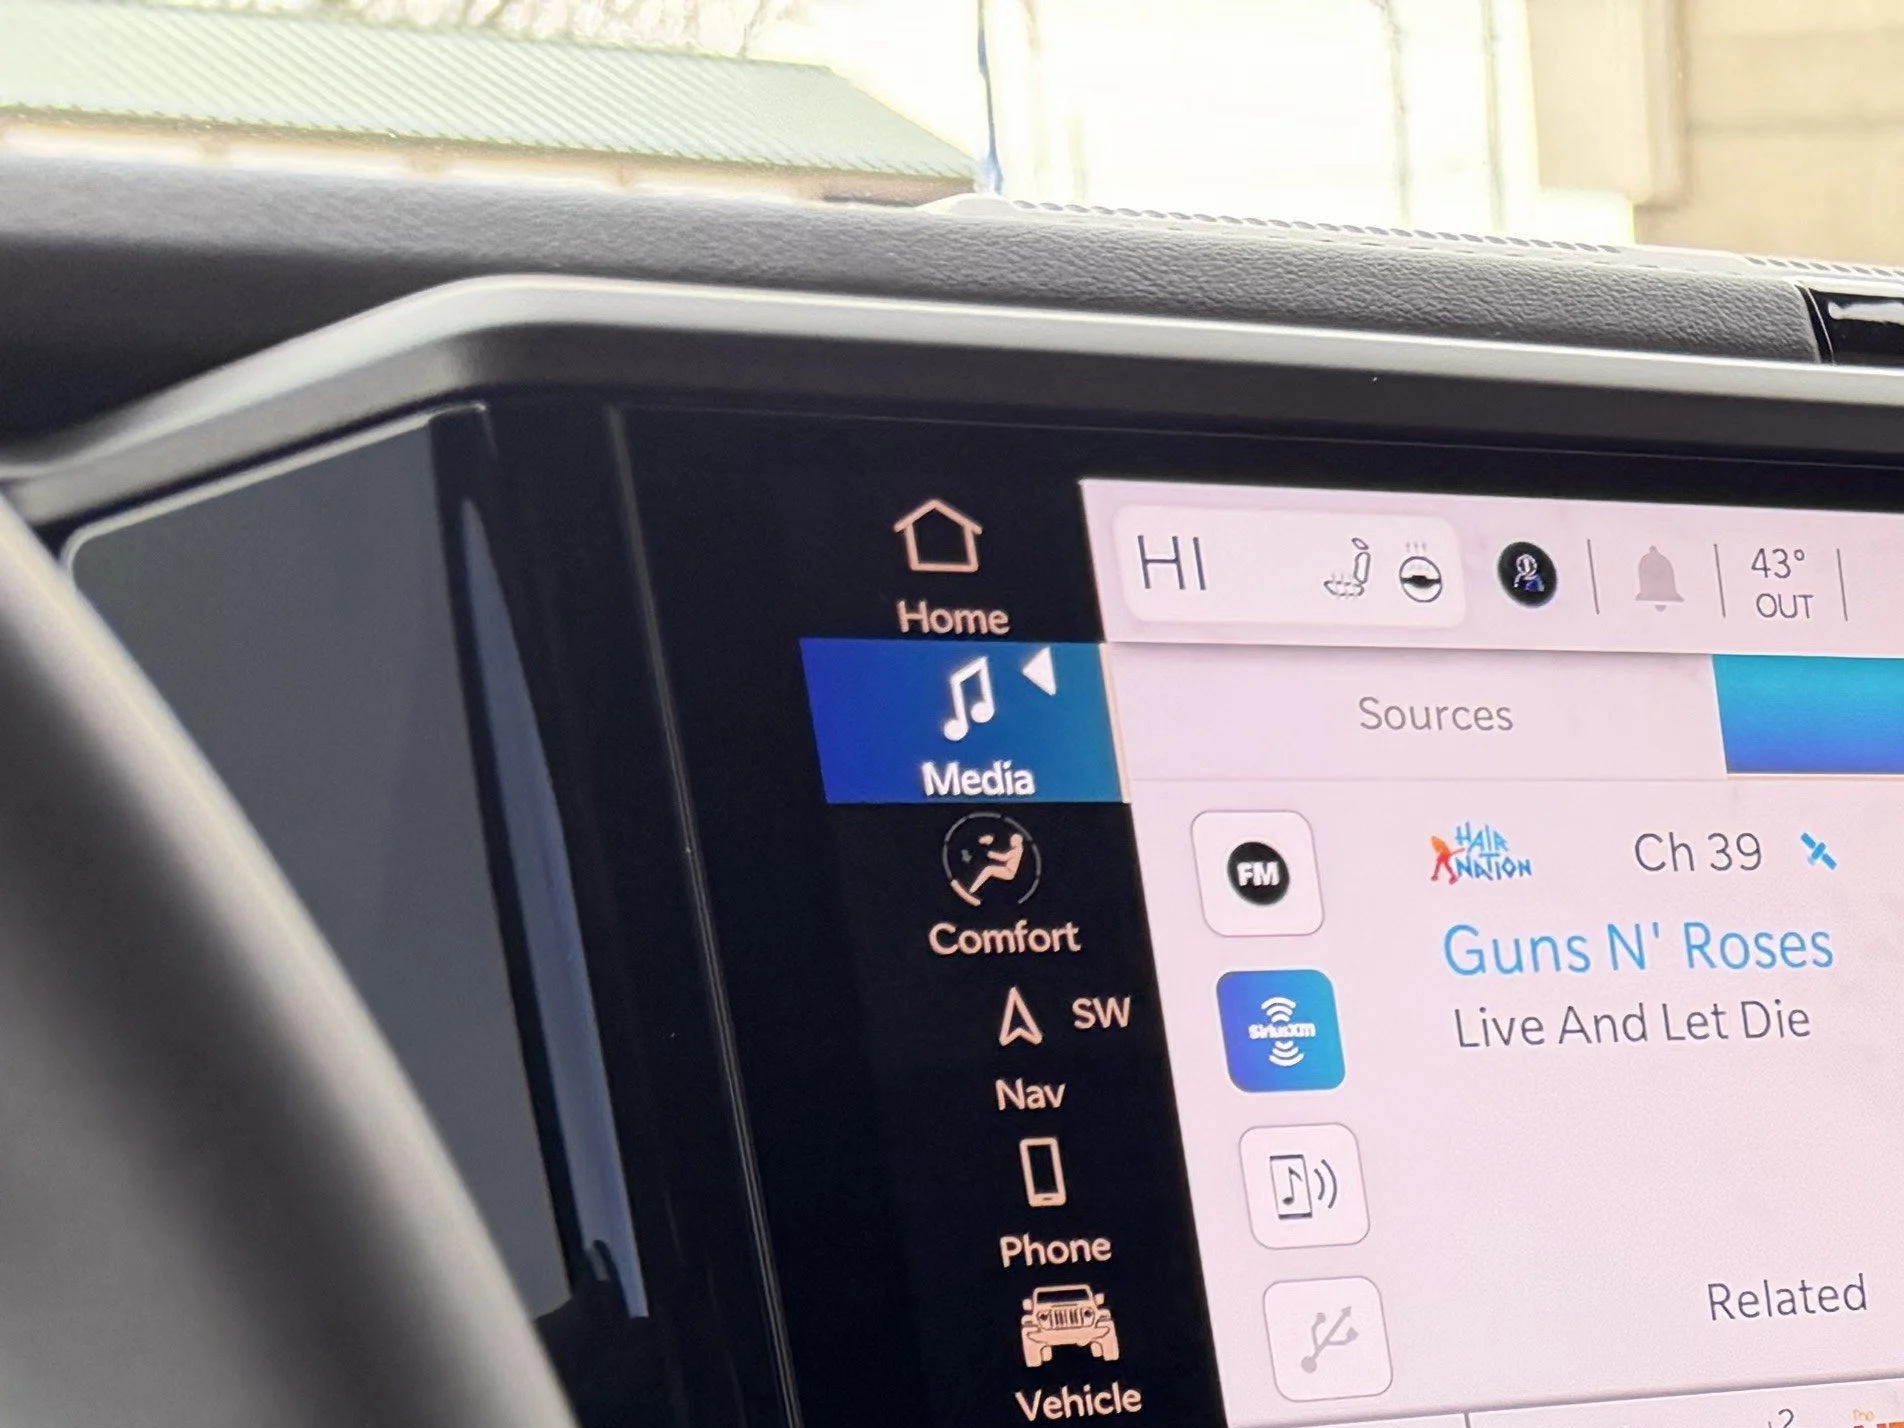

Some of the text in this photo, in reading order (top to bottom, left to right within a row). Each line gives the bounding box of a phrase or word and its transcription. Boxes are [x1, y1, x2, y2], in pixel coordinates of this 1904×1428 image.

[1136, 535, 1208, 592] HI
[1750, 547, 1806, 580] 43°
[899, 602, 1010, 636] Home
[1755, 592, 1814, 620] OUT
[1358, 695, 1514, 732] Sources
[921, 761, 1036, 796] Media
[1455, 821, 1510, 852] HAIR
[1634, 832, 1764, 872] Ch 39
[1237, 862, 1280, 889] FM
[1455, 851, 1533, 882] NATION
[928, 921, 1082, 956] Comfort
[1443, 920, 1835, 976] Guns N' Roses
[1072, 997, 1132, 1029] SW
[1454, 998, 1812, 1048] Live And Let Die
[995, 1078, 1066, 1111] Nav
[1000, 1234, 1113, 1268] Phone
[1706, 1273, 1869, 1322] Related
[1016, 1384, 1143, 1422] Vehicle
